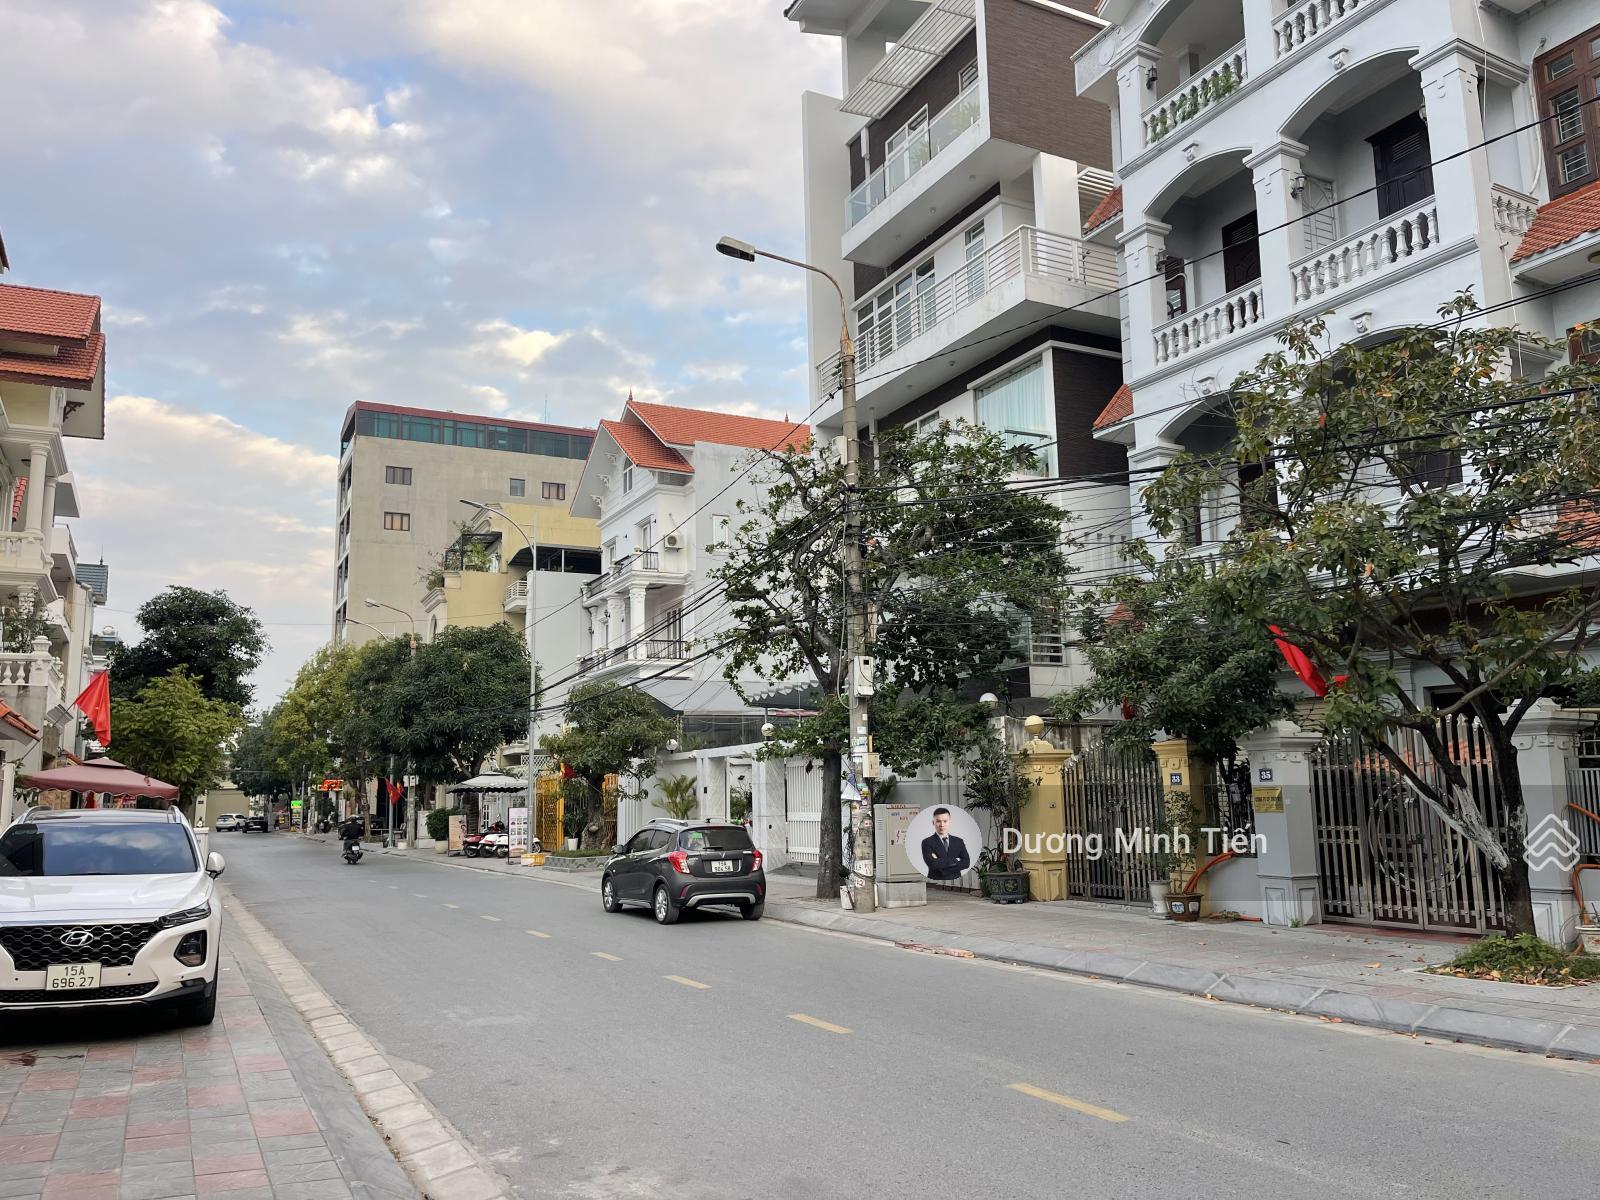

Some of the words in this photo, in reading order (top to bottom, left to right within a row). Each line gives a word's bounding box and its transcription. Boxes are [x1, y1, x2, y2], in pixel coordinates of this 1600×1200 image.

[1171, 775, 1181, 783] 33
[1260, 771, 1272, 780] 35
[64, 965, 85, 976] 15A
[52, 976, 95, 989] 696.27
